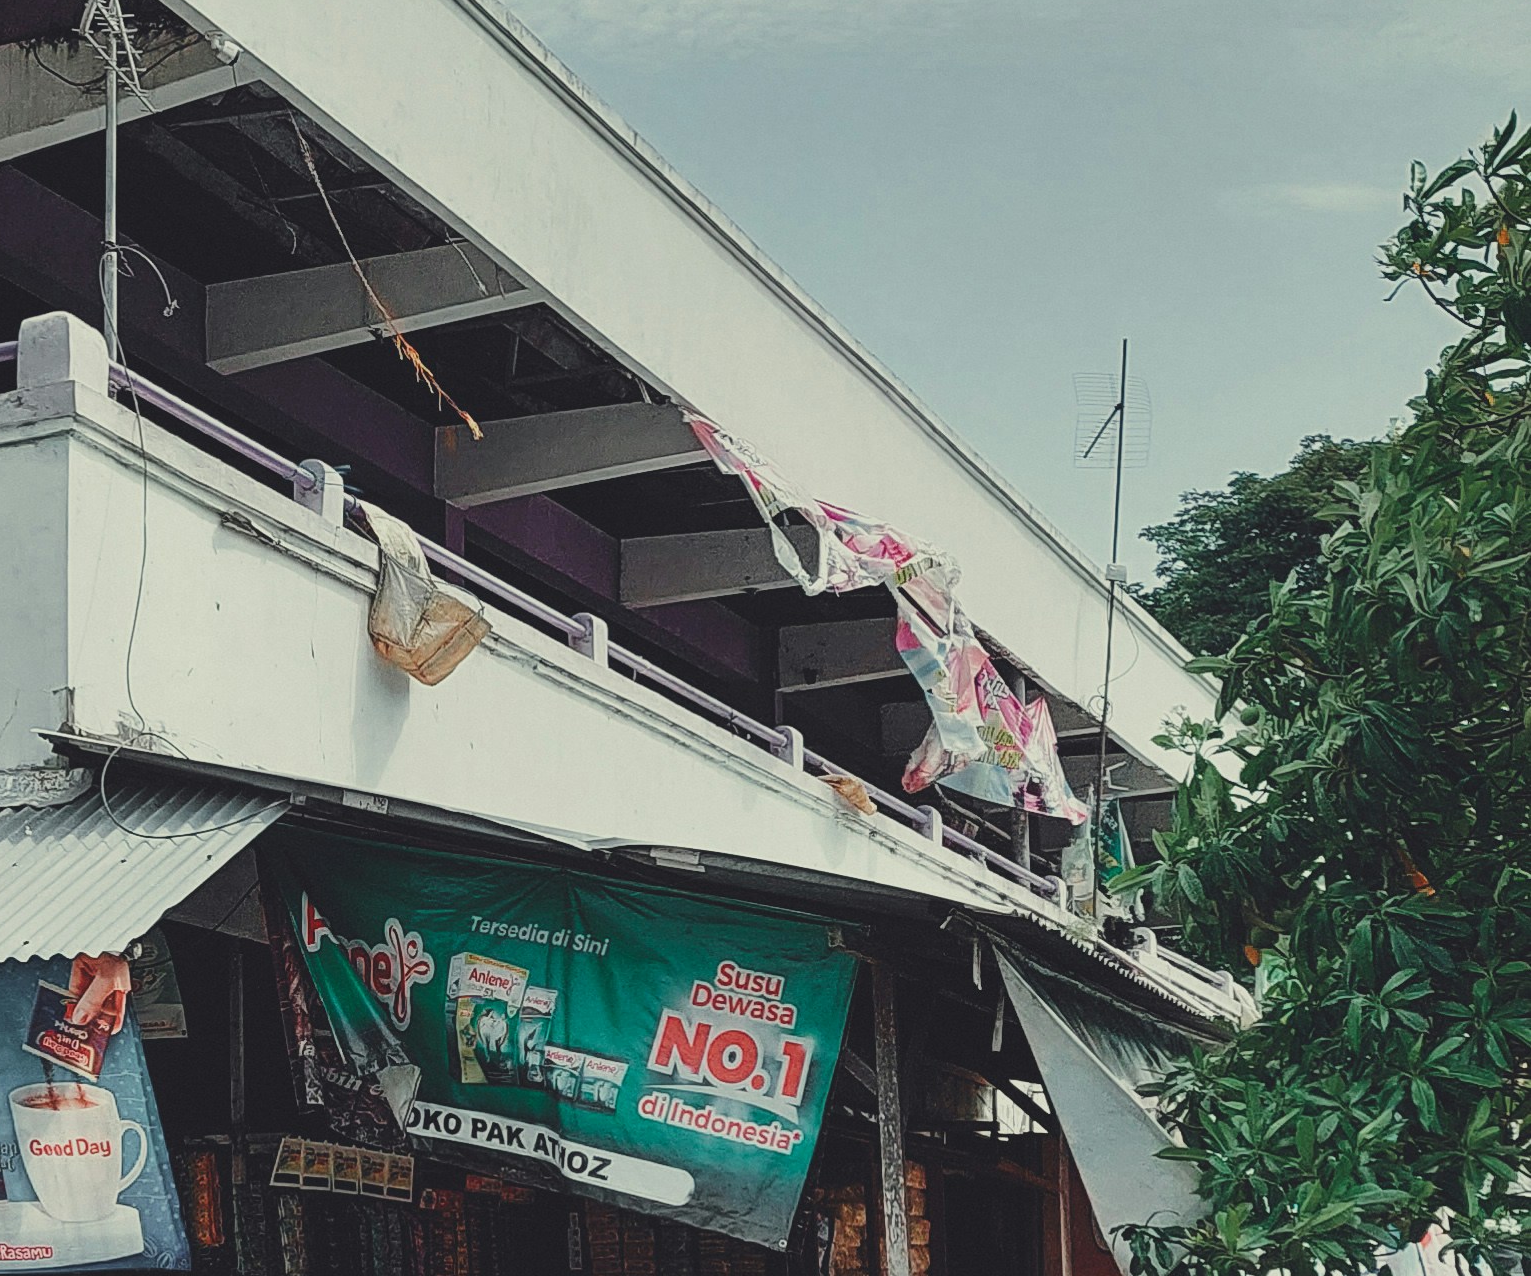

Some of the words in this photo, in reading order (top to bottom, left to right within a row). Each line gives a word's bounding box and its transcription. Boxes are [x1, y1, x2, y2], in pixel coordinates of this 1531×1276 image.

[471, 916, 549, 944] Tersedia
[552, 930, 571, 947] di
[573, 934, 610, 957] Sini
[469, 967, 510, 990] Anlene
[717, 963, 782, 997] Susu
[692, 983, 796, 1026] Dewasa
[655, 1014, 807, 1099] NO.1
[641, 1095, 667, 1119] di
[406, 1107, 462, 1136] OKO
[471, 1117, 526, 1150] PAK
[29, 1138, 73, 1157] Good
[77, 1138, 113, 1158] Day
